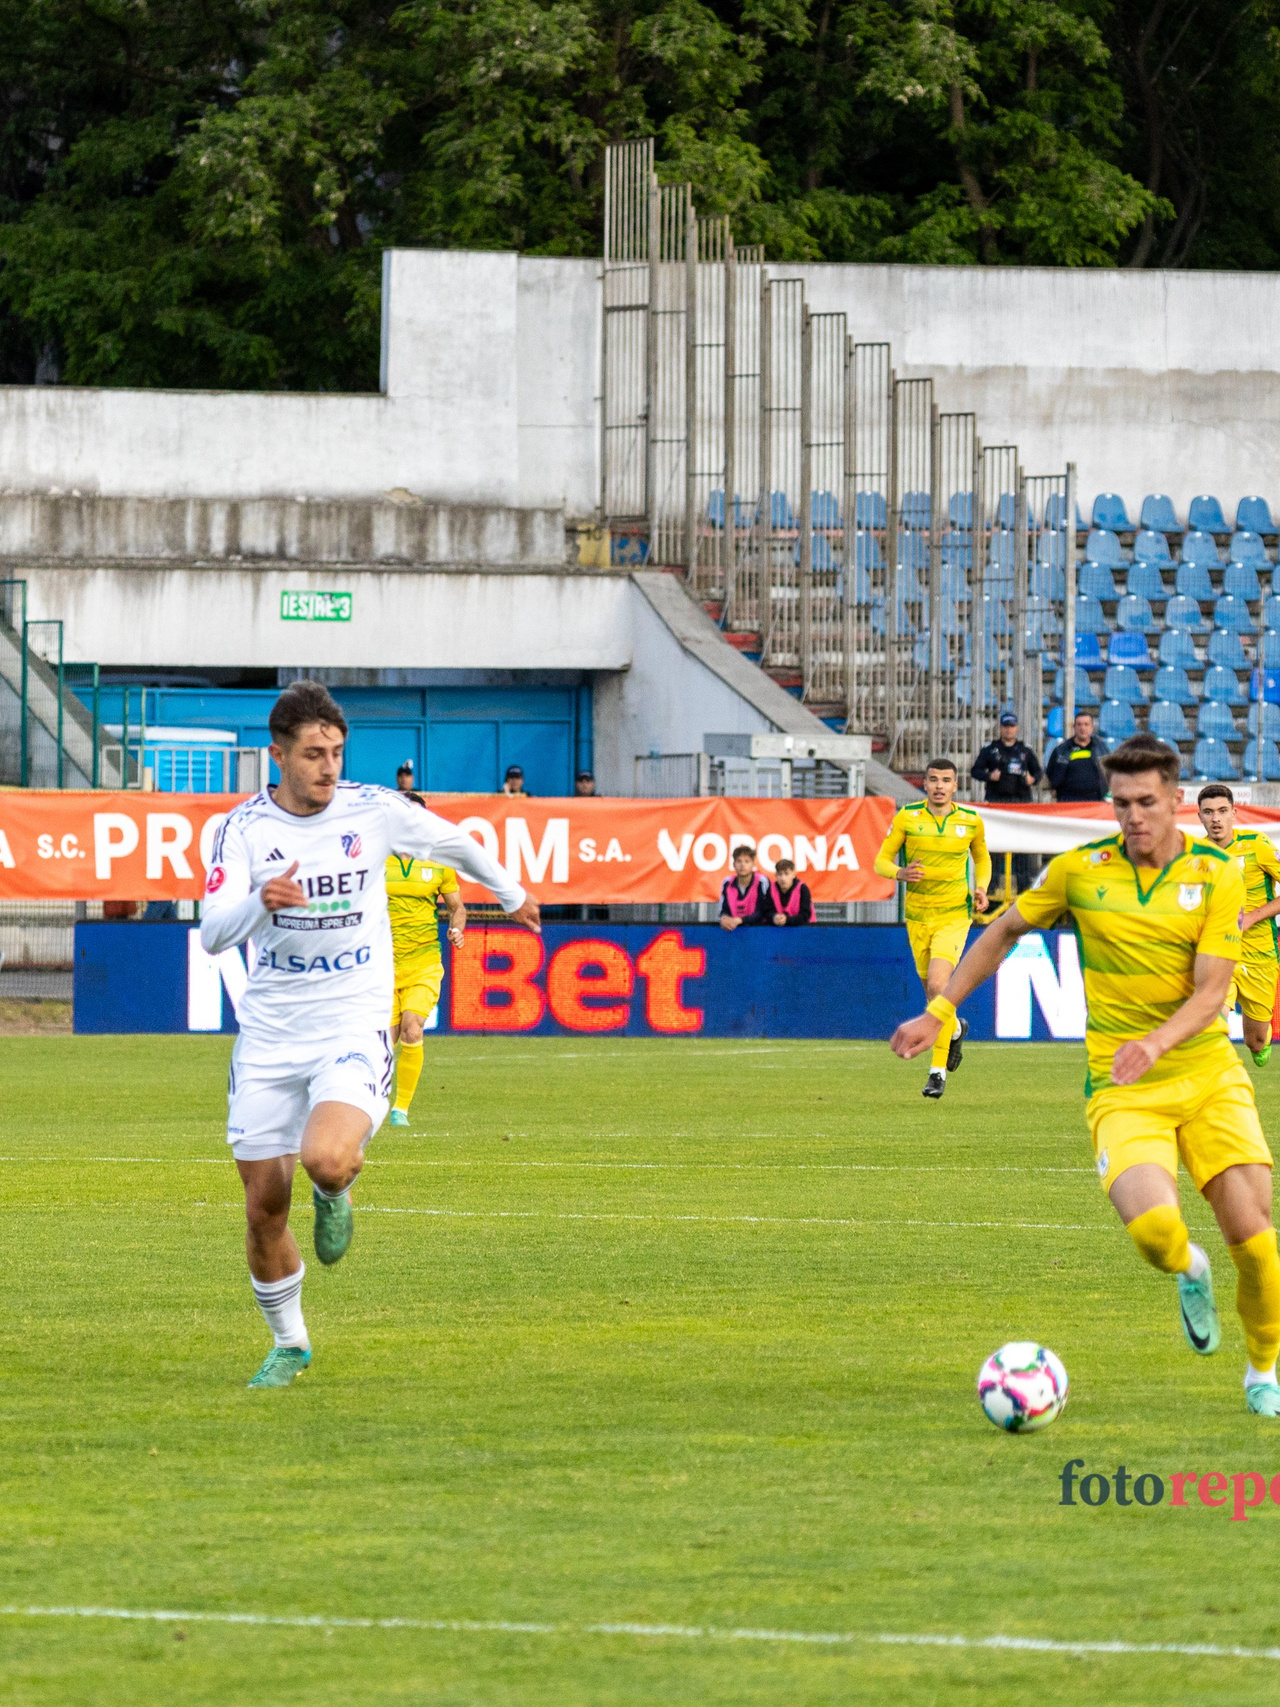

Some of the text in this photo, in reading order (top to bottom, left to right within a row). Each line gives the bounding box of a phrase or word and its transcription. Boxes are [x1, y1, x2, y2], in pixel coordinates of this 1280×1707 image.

[37, 833, 86, 859] S.C.
[578, 837, 632, 863] S.A.
[297, 869, 369, 898] IBET
